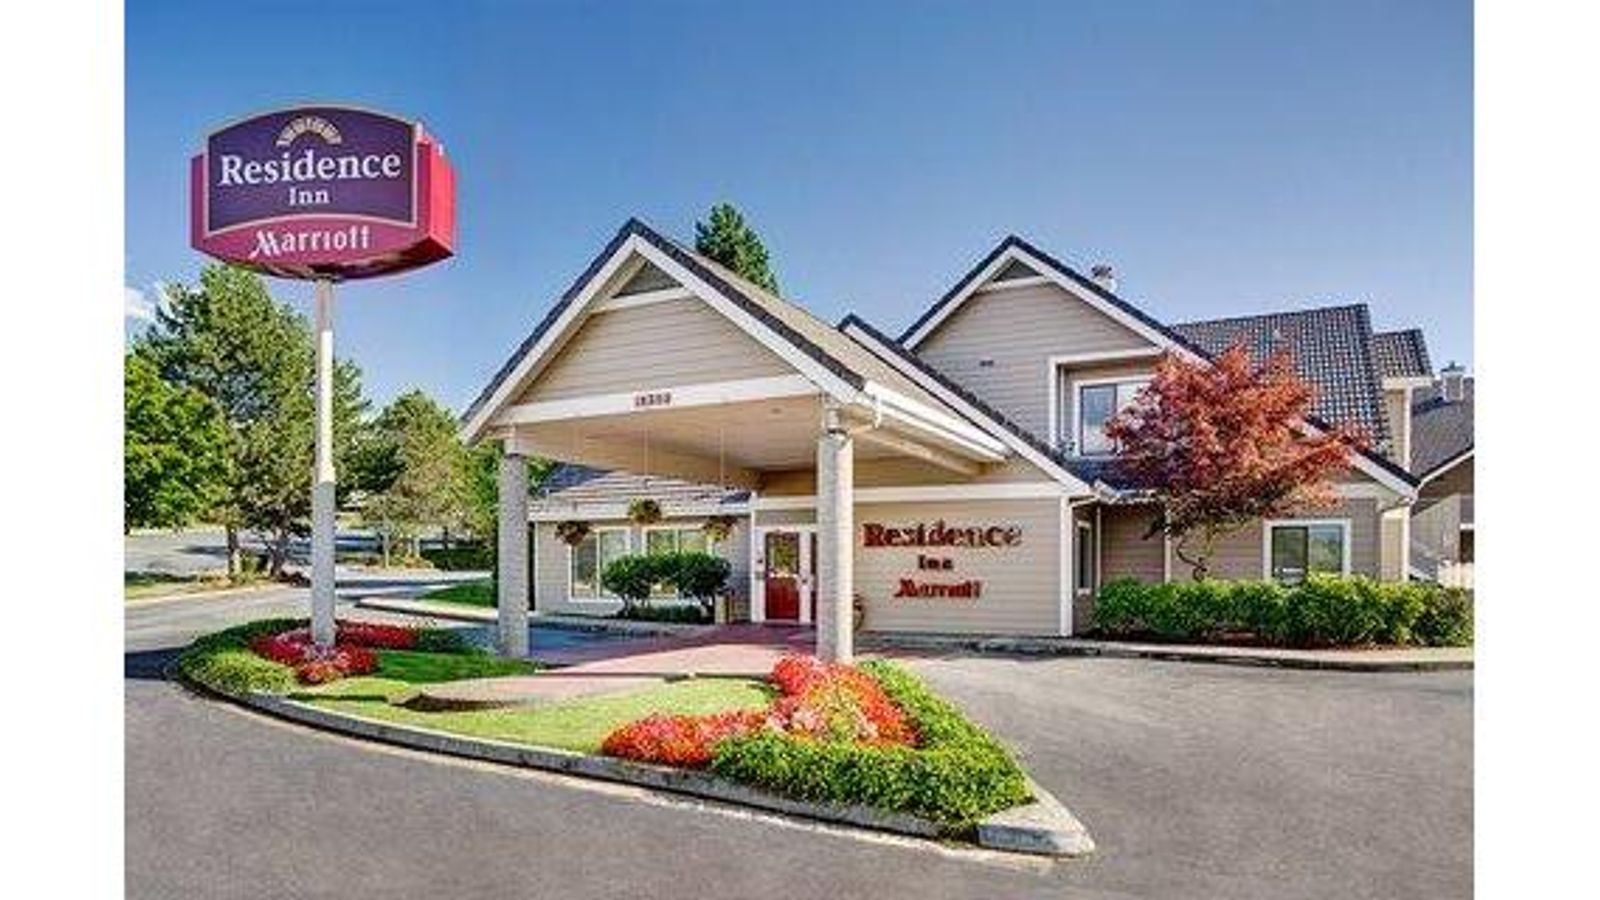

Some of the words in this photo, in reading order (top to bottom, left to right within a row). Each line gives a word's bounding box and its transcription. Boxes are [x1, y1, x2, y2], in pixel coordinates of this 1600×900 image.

[218, 150, 401, 186] Residence
[289, 187, 330, 206] Inn
[250, 226, 370, 259] Marriott
[862, 520, 1023, 547] Residence
